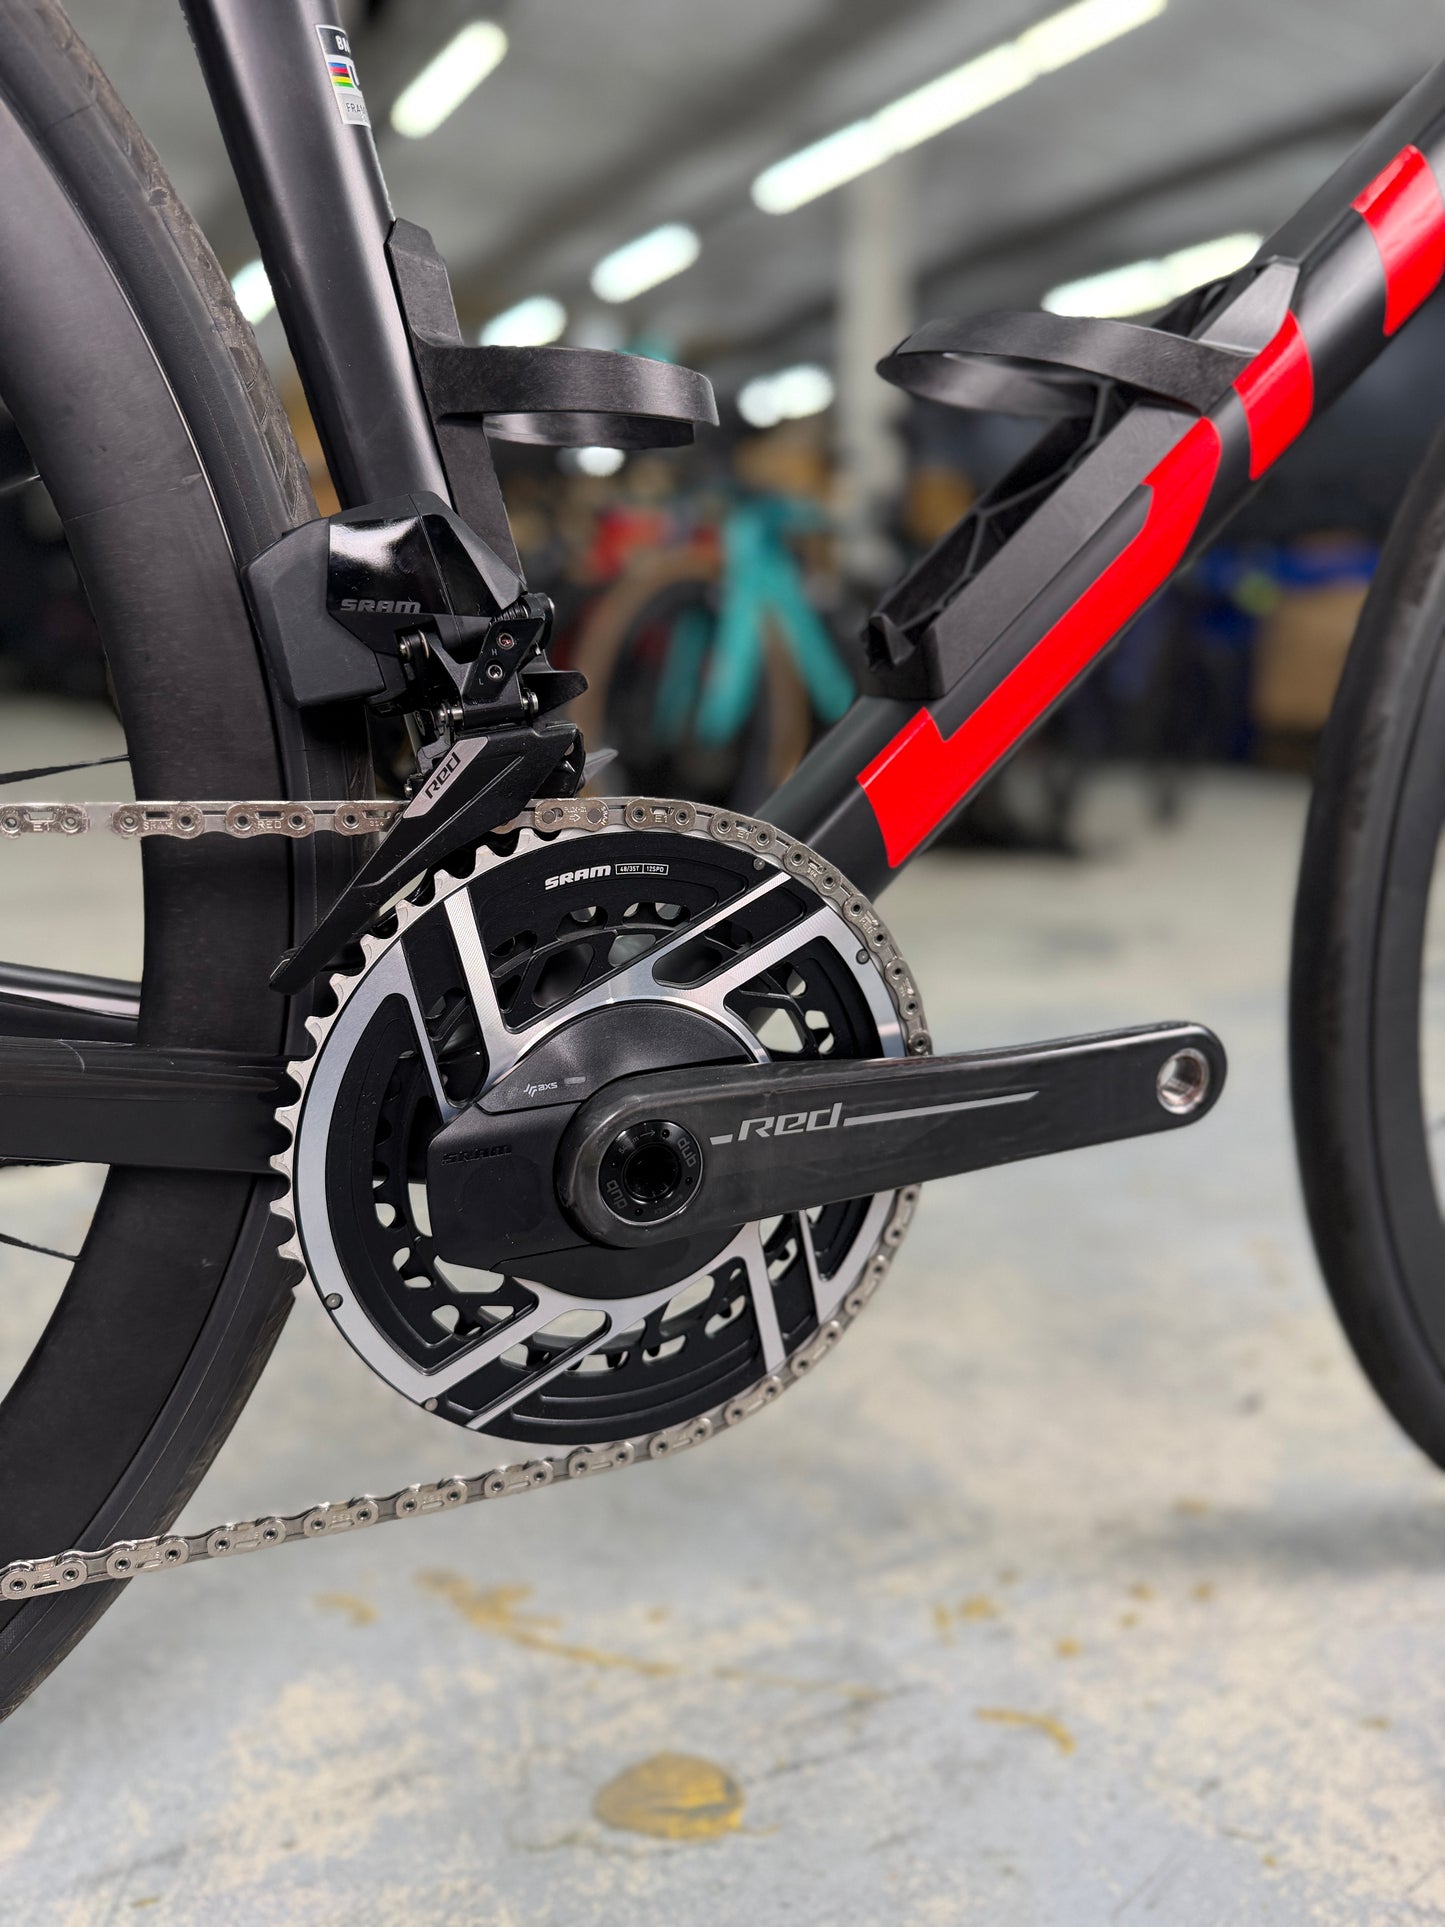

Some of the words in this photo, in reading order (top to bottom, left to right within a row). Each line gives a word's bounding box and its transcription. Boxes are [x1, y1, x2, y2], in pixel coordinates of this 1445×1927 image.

[340, 599, 421, 614] SRAM
[491, 648, 498, 656] H
[478, 678, 484, 686] L
[143, 821, 175, 831] SRAM
[257, 820, 282, 829] RED
[545, 865, 612, 891] SRAM
[537, 1081, 558, 1092] axs
[677, 1137, 697, 1168] dub
[605, 1178, 628, 1209] dub
